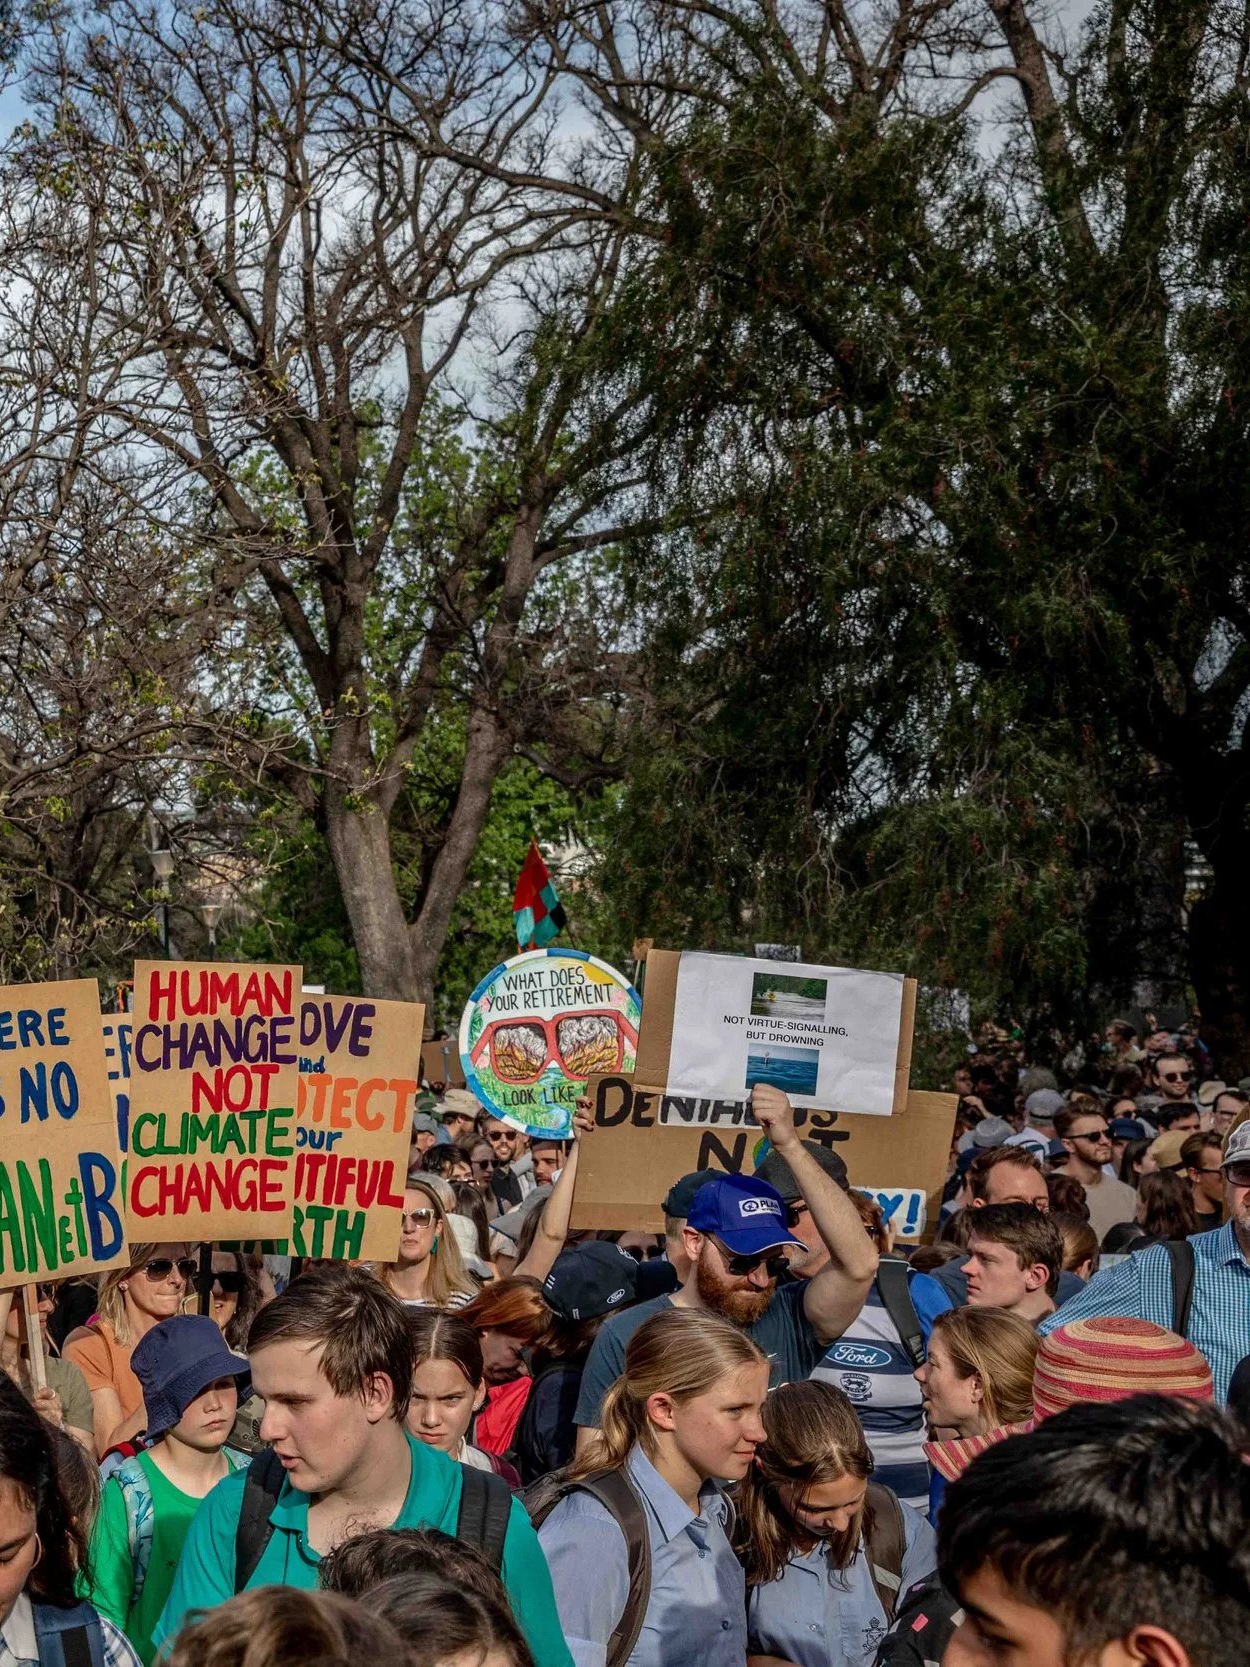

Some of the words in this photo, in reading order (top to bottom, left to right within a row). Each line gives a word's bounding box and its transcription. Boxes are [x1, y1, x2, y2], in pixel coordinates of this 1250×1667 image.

[149, 970, 292, 1021] HUMAN
[486, 995, 519, 1013] YOUR
[523, 983, 614, 1009] RETIREMENT
[503, 971, 545, 991] WHAT
[550, 966, 585, 987] DOES
[135, 1014, 297, 1072] CHANGE
[300, 1002, 376, 1056] OVE
[723, 1015, 745, 1025] NOT
[747, 1018, 849, 1037] VIRTUE-SIGNALLING,
[746, 1030, 766, 1040] BUT
[769, 1033, 824, 1046] DROWNING
[20, 1061, 79, 1123] NO
[192, 1064, 279, 1113] NOT
[297, 1074, 417, 1133] TECT
[503, 1089, 537, 1107] LOOK
[543, 1086, 575, 1104] LIKE
[132, 1108, 294, 1157] CLIMATE
[131, 1158, 288, 1217] CHANGE
[294, 1153, 404, 1208] TIFUL
[78, 1152, 124, 1261] B
[834, 1345, 878, 1364] Ford
